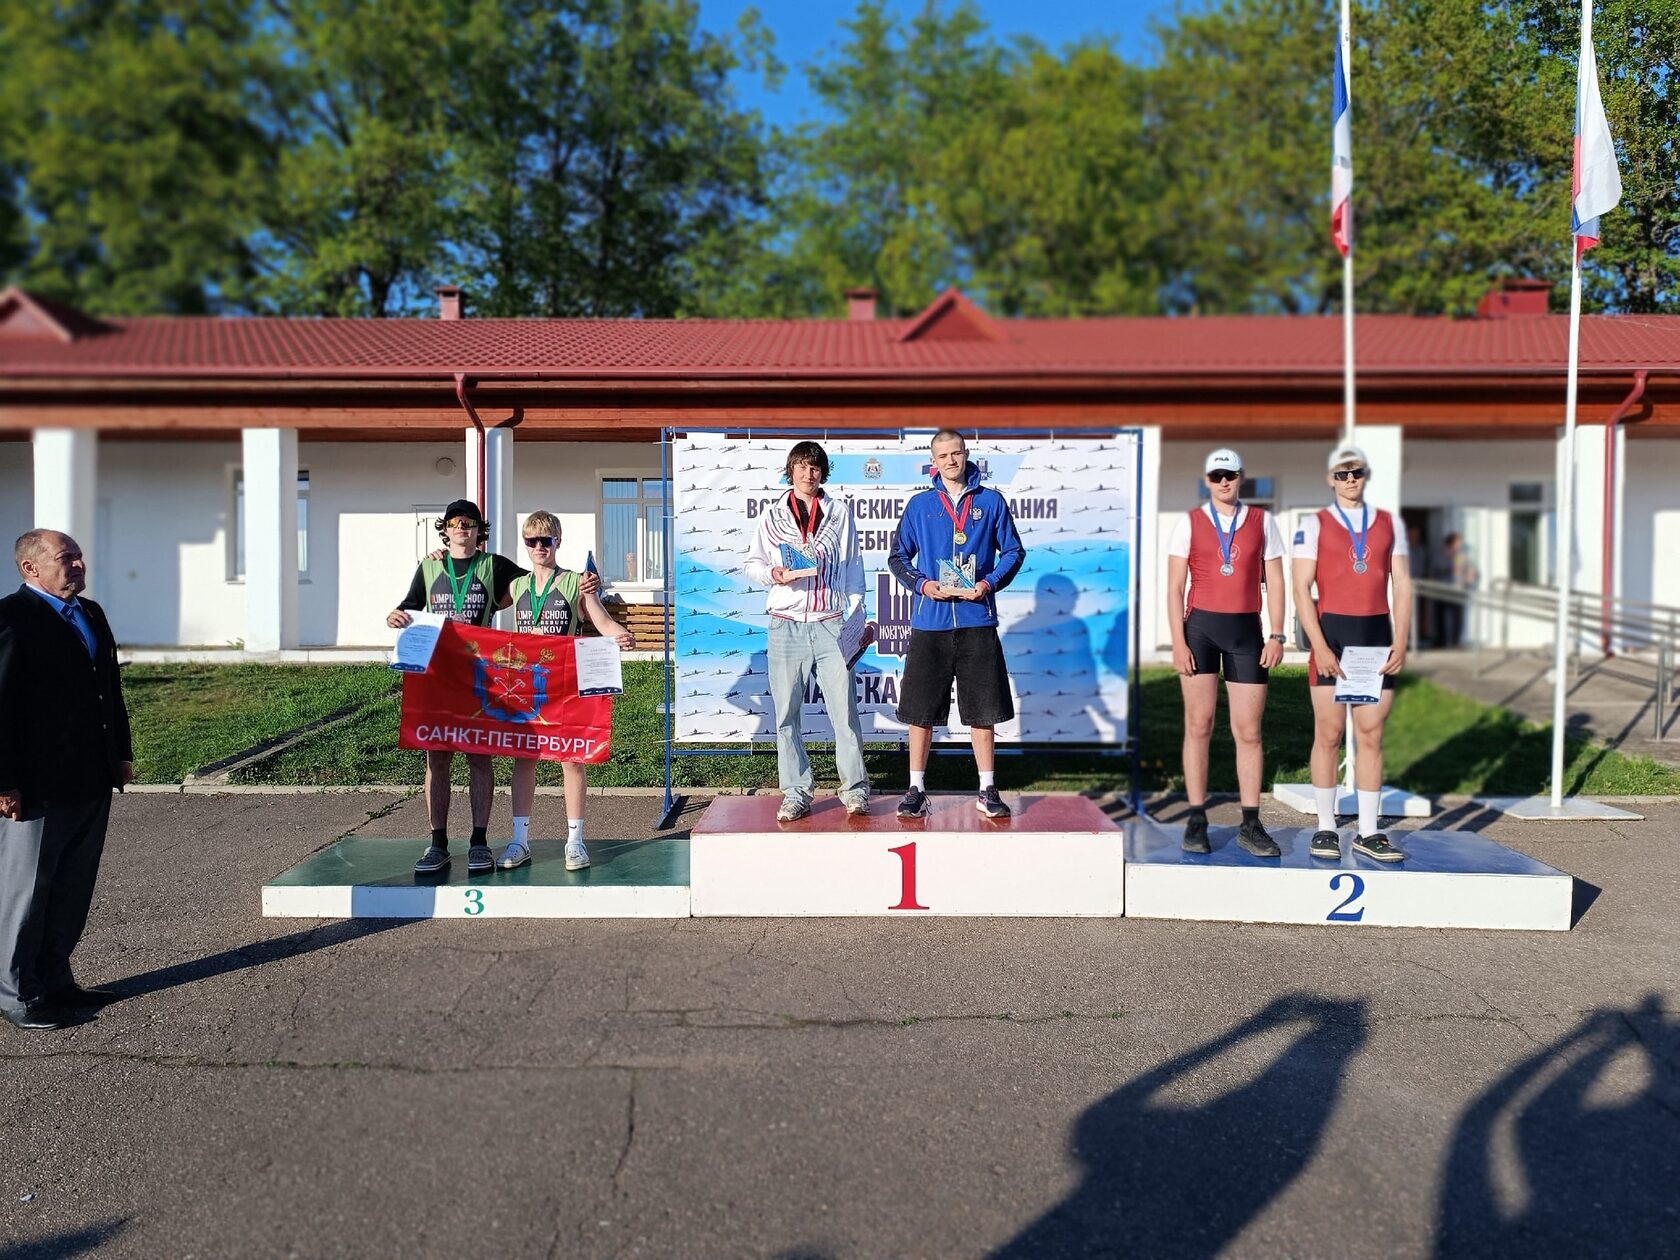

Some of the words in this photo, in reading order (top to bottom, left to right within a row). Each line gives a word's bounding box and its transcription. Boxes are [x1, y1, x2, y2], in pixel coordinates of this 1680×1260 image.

[415, 725, 596, 754] САНКТ-ПЕТЕРБУРГ
[888, 842, 930, 910] 1
[464, 889, 485, 915] 3
[1326, 873, 1365, 922] 2
